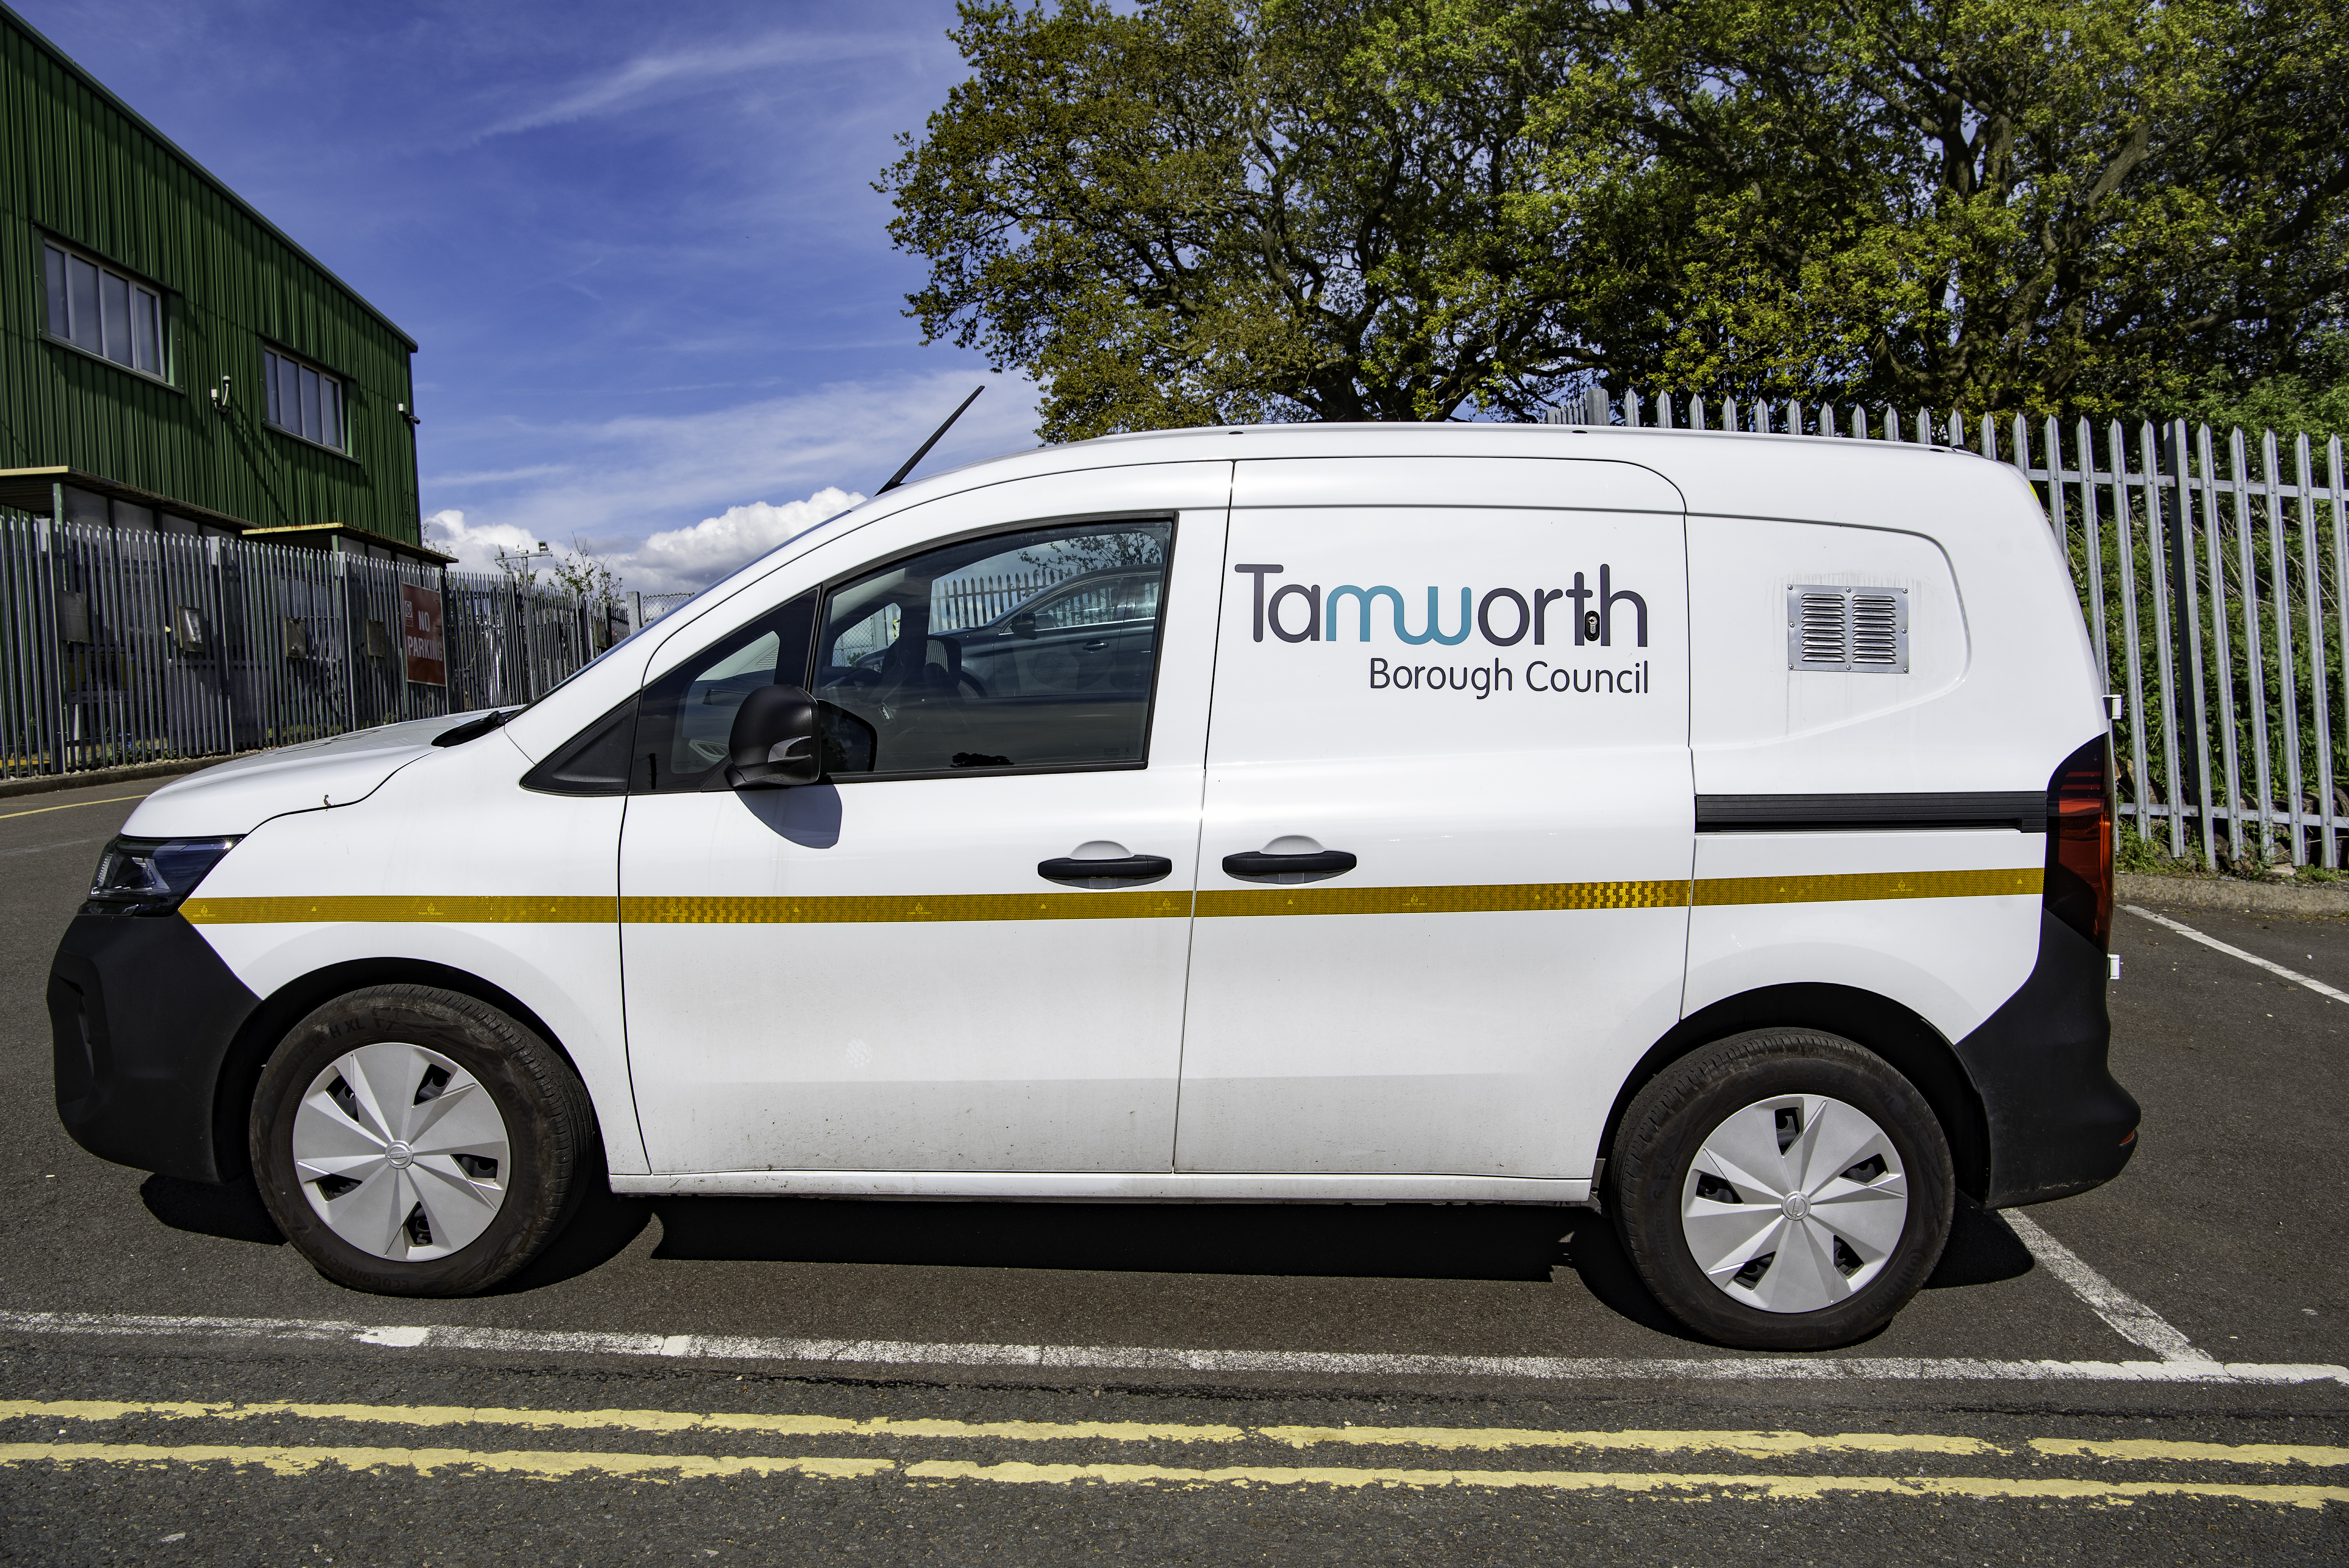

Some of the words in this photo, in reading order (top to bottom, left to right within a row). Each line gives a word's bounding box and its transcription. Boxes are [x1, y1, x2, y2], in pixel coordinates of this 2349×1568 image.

[1235, 564, 1647, 647] Tamworth
[418, 610, 430, 632] NO
[407, 636, 443, 661] PARKING
[1371, 657, 1512, 699] Borough
[1526, 661, 1648, 693] Council
[329, 1025, 342, 1039] H
[344, 1017, 365, 1033] XL
[289, 1094, 299, 1113] OUTSIDE
[1652, 1189, 1666, 1201] 6
